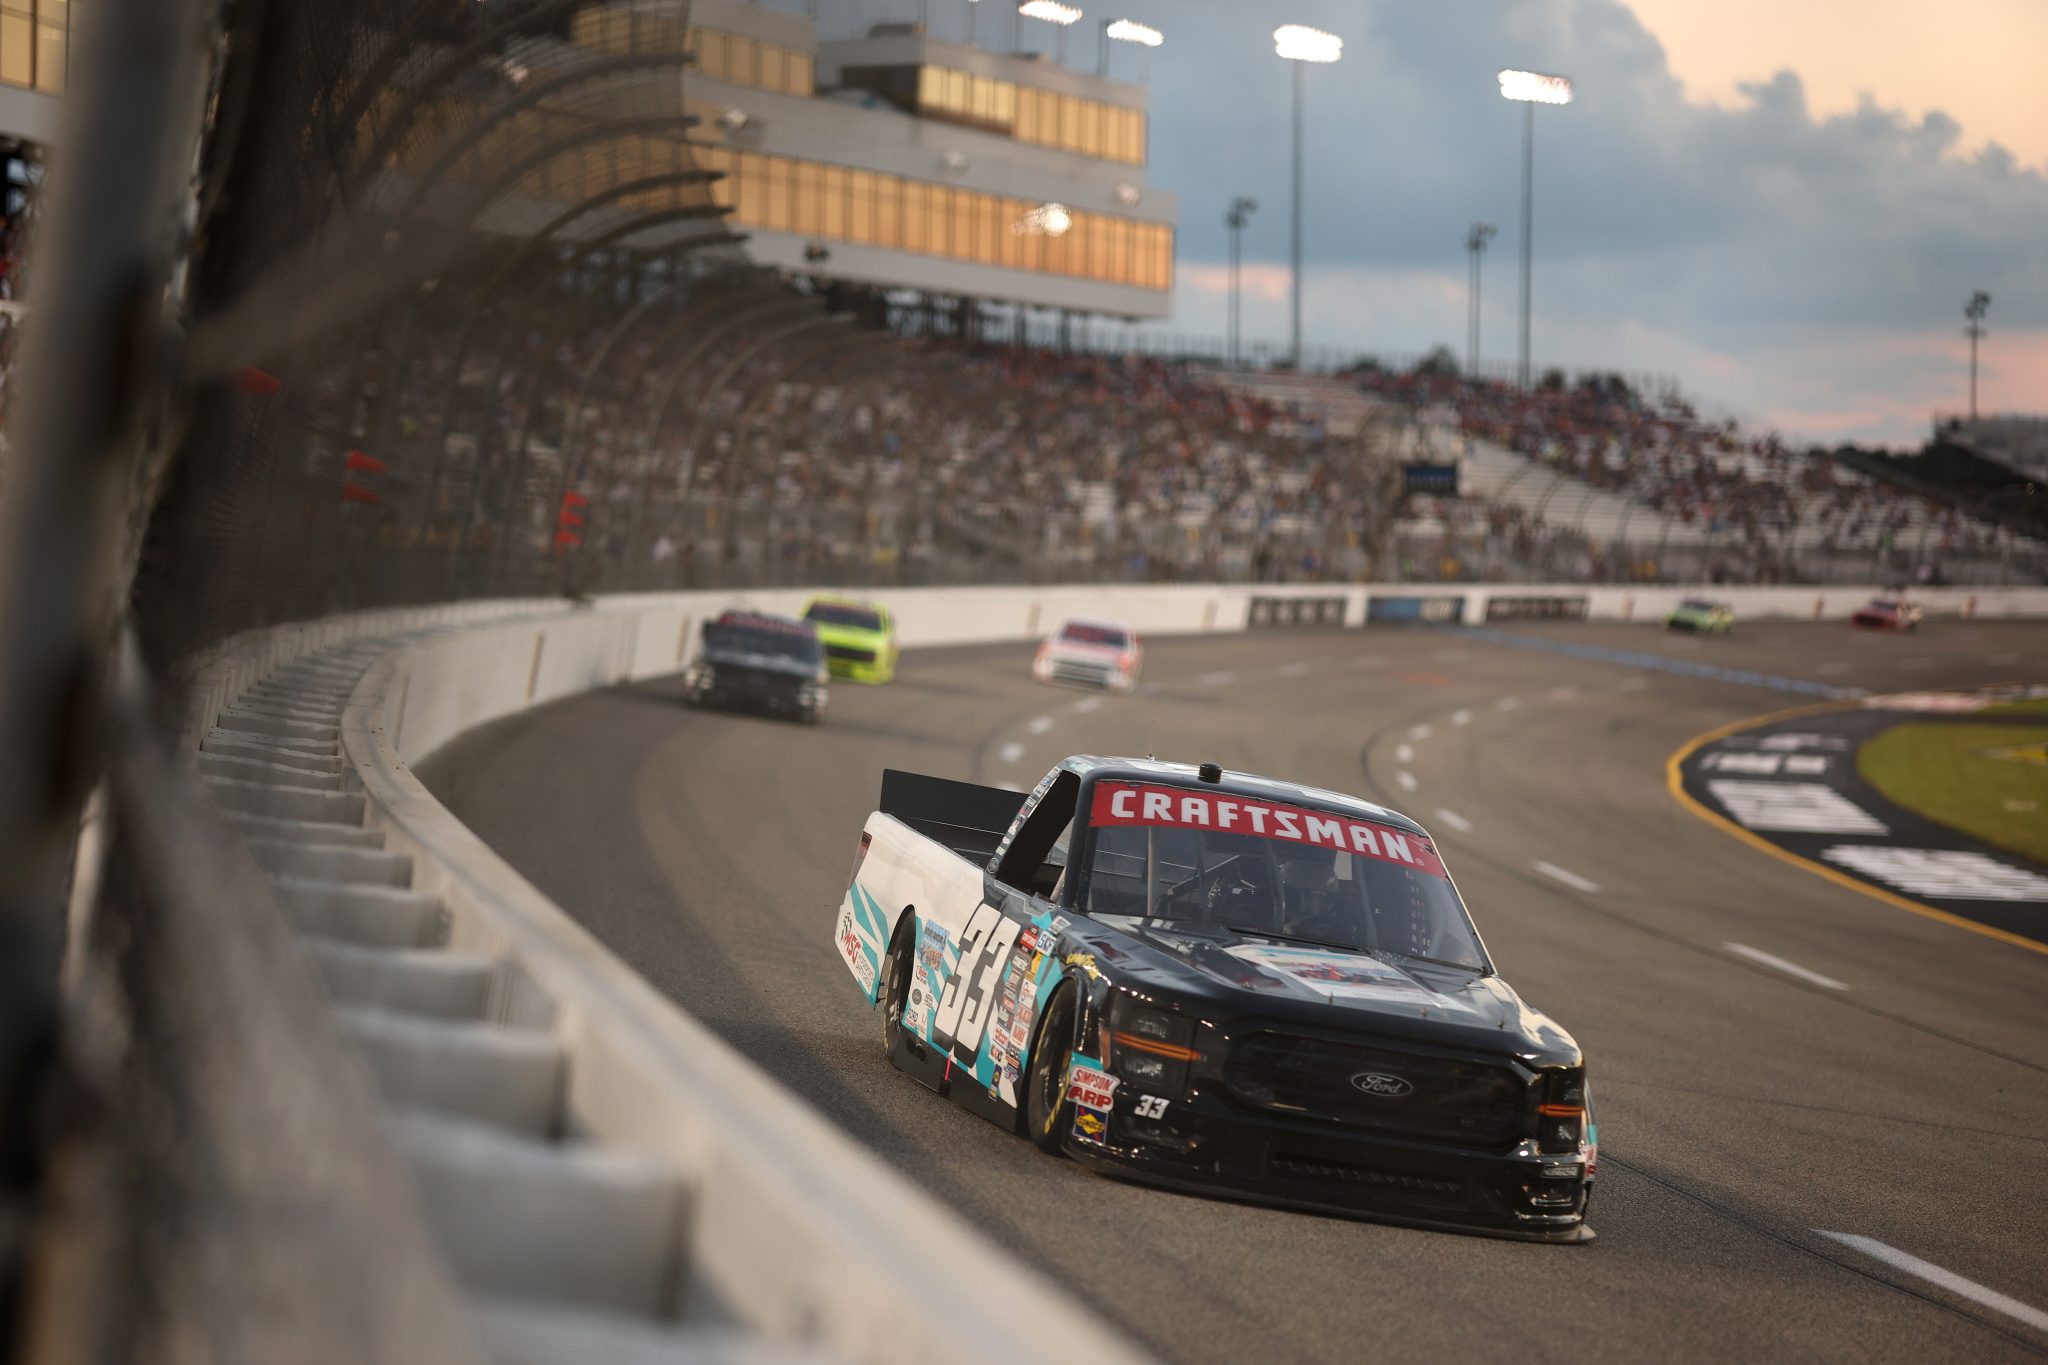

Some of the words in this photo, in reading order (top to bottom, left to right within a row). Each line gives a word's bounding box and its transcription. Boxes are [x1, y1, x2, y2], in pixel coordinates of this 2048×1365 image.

[1111, 790, 1415, 864] CRAFTSMAN
[935, 903, 1021, 1052] 33
[1074, 1069, 1113, 1092] SIMPSON
[1361, 1075, 1402, 1094] Ford
[1068, 1086, 1112, 1107] ARP
[1134, 1094, 1170, 1120] 33
